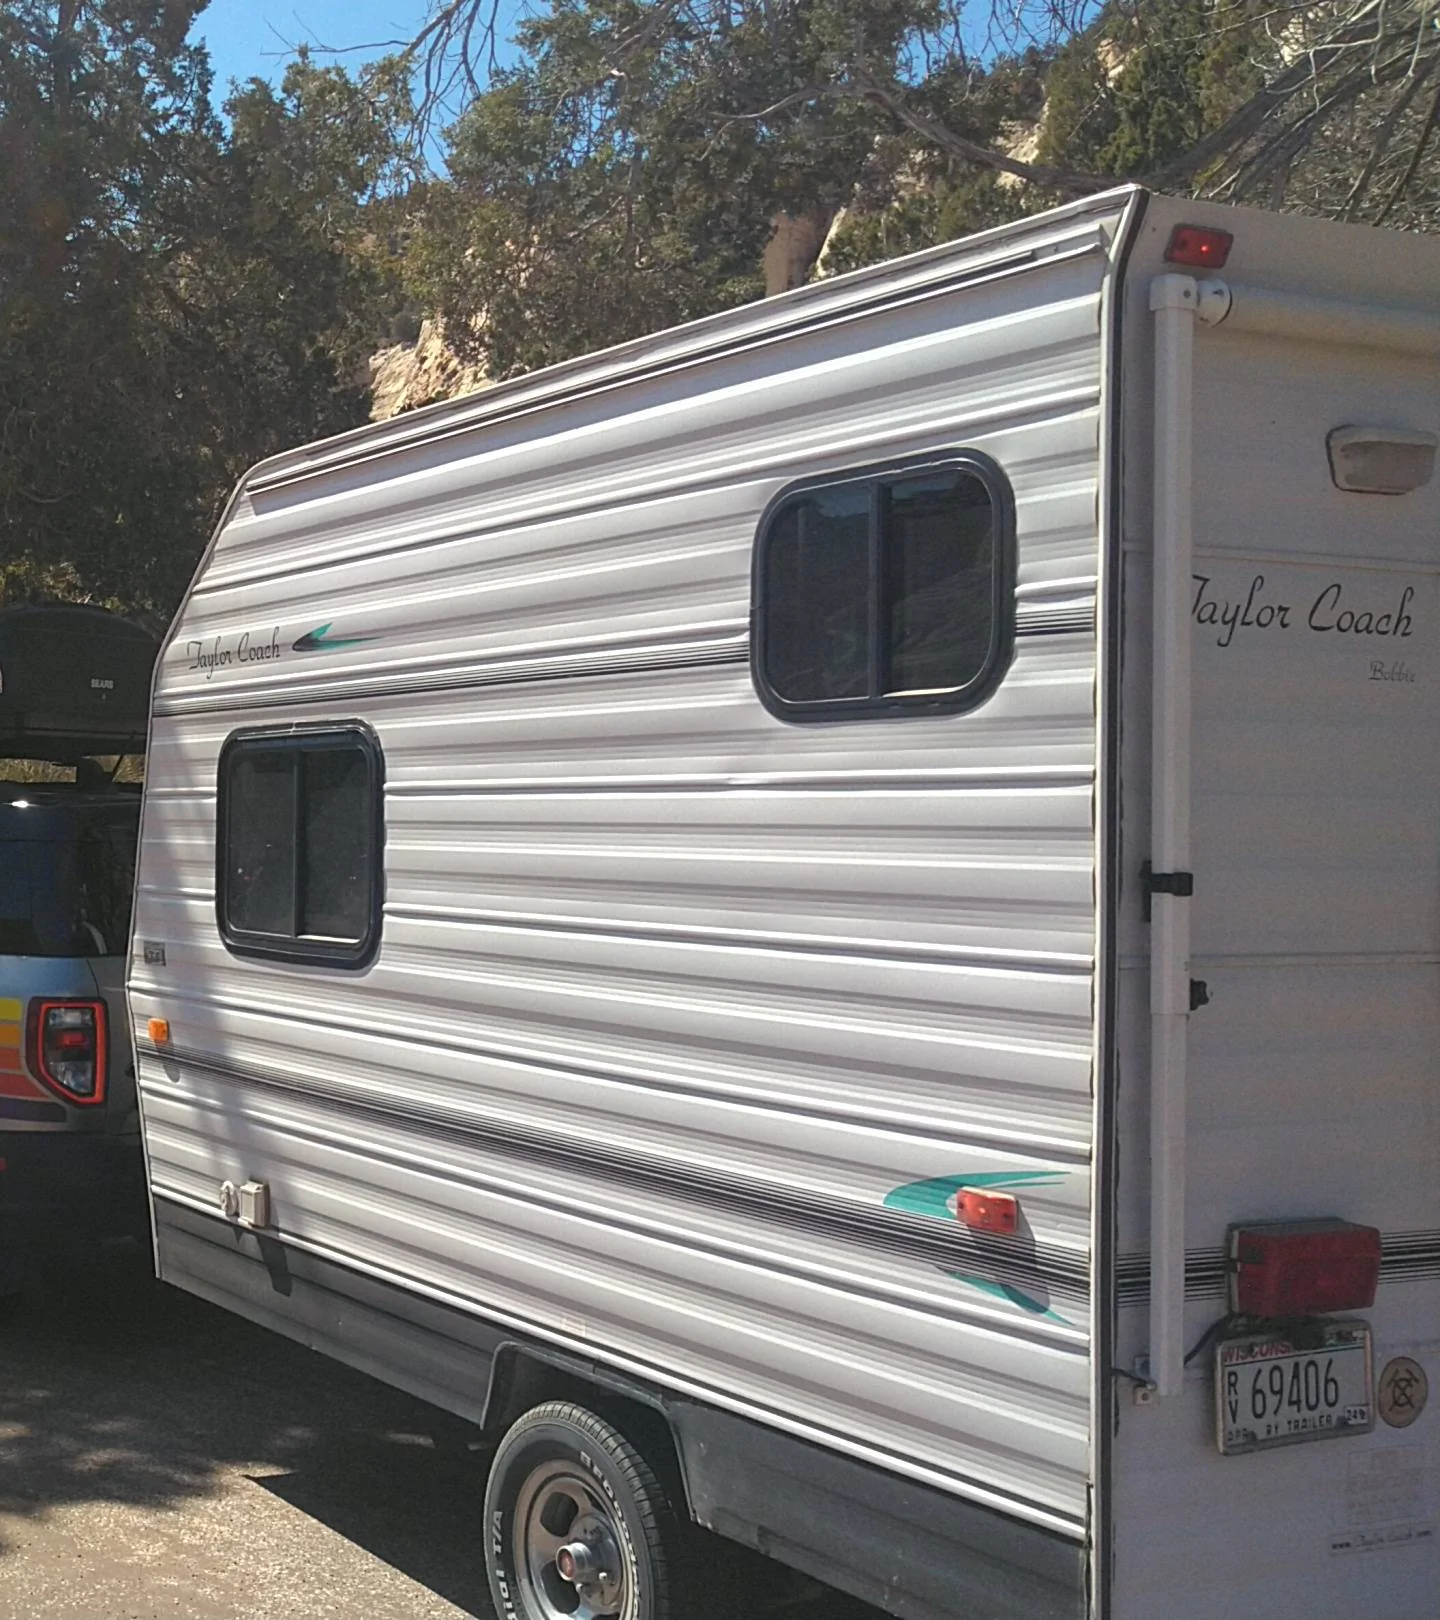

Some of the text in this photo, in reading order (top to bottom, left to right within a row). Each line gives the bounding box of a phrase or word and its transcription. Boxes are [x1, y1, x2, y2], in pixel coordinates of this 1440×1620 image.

[1192, 575, 1415, 647] Taylor Coach
[187, 626, 280, 679] Taylor Coach
[1223, 1341, 1293, 1363] WISCONS
[1252, 1358, 1339, 1419] 69406
[1287, 1414, 1333, 1432] TRAILER
